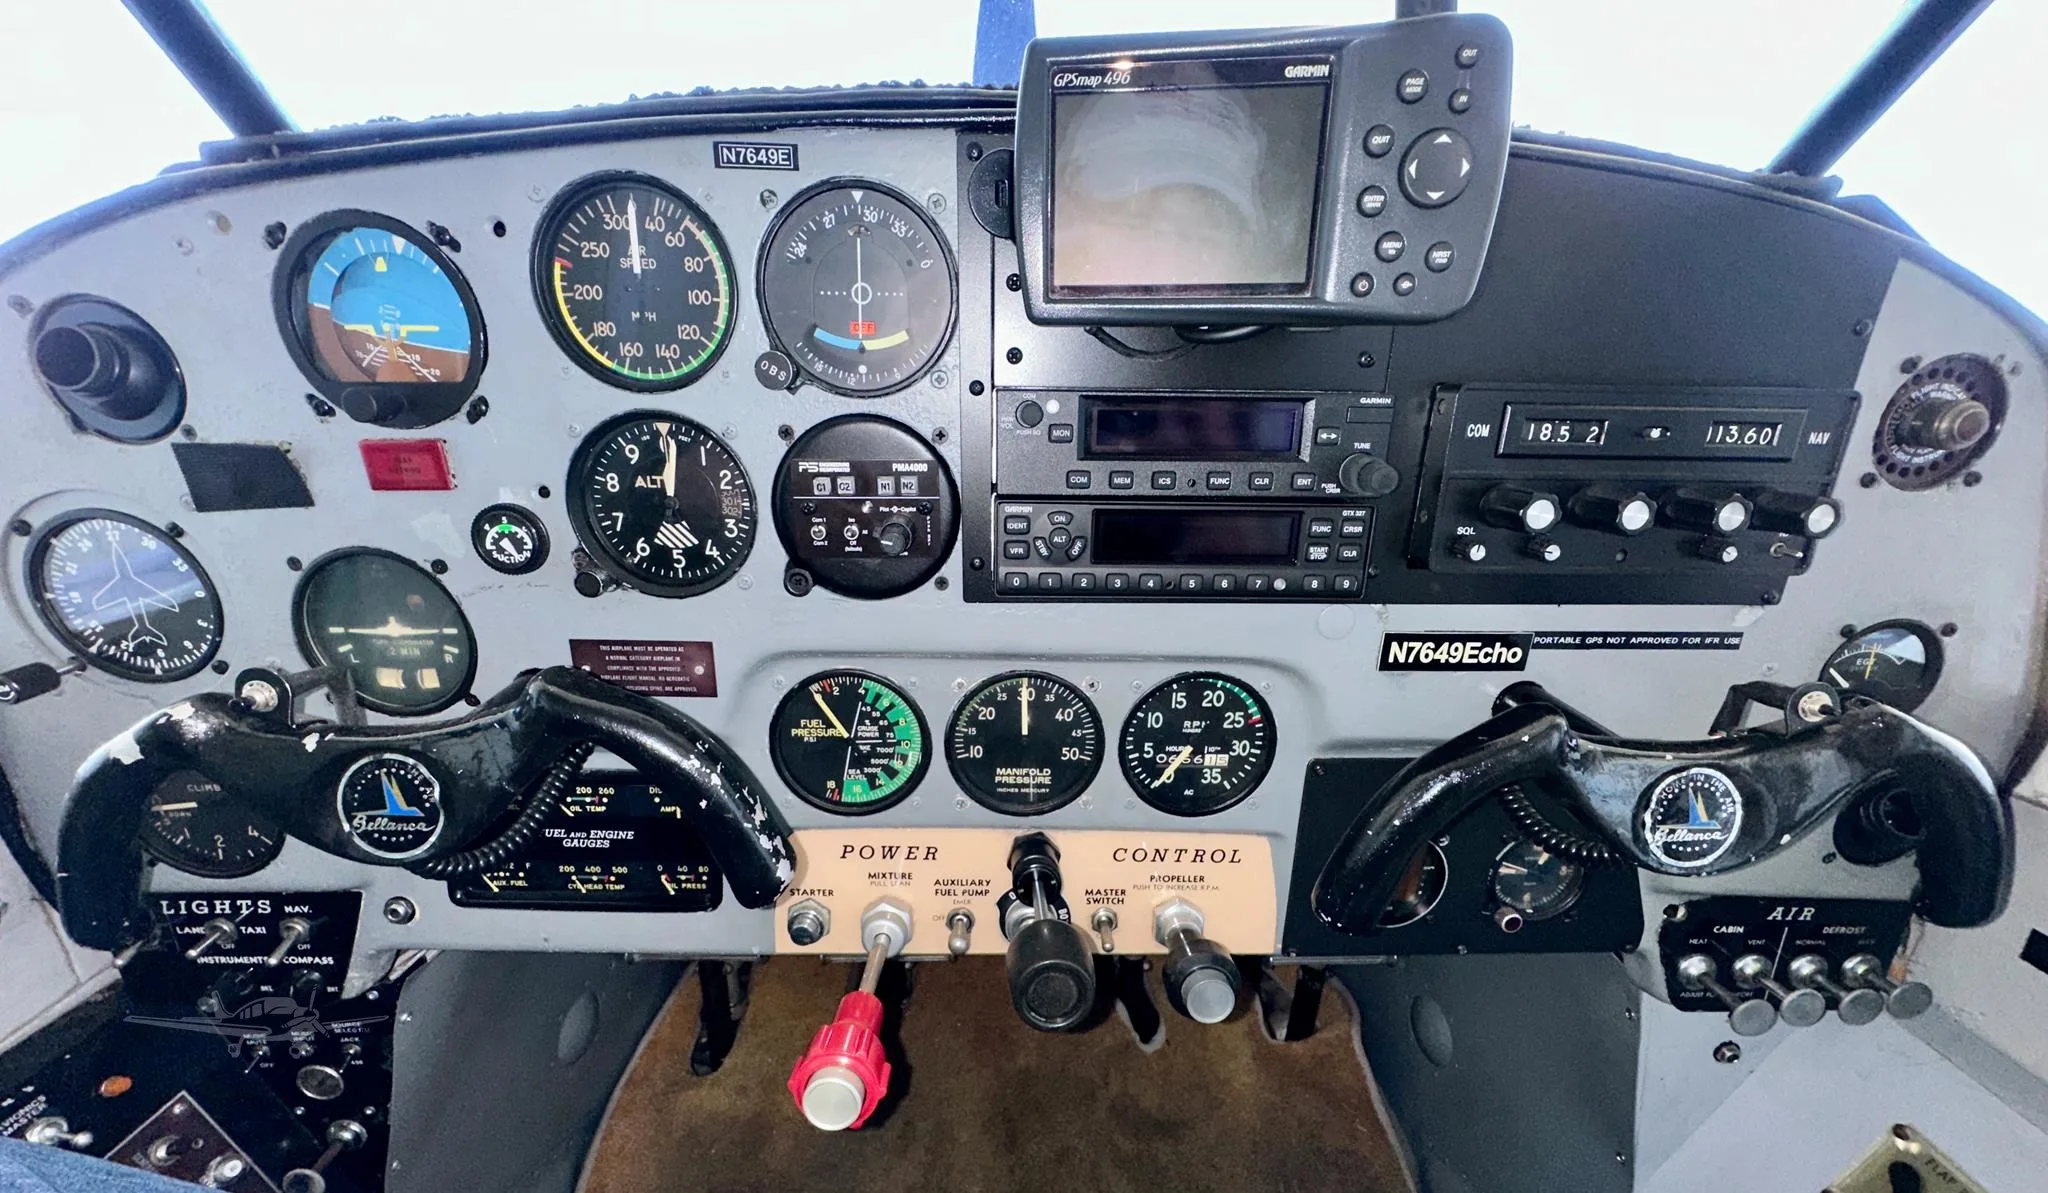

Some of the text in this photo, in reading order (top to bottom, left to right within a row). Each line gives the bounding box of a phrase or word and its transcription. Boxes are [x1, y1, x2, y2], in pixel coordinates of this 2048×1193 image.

[1462, 49, 1478, 57] OUT
[1284, 65, 1330, 78] GARMIN
[1053, 71, 1131, 88] GPSmap 496
[1405, 78, 1425, 86] PAGE
[1459, 95, 1468, 103] IN
[1371, 135, 1391, 144] QUIT
[722, 147, 790, 165] N7649E
[603, 214, 631, 231] 300
[822, 213, 836, 229] 27
[863, 211, 879, 223] 30
[644, 216, 665, 232] 40
[664, 232, 686, 248] 60
[1382, 241, 1402, 249] MENU
[580, 242, 610, 258] 250
[628, 246, 647, 256] AR
[620, 258, 657, 270] SPED
[684, 256, 704, 273] 80
[573, 284, 603, 300] 200
[687, 289, 712, 306] 100
[593, 321, 616, 337] 180
[677, 324, 700, 340] 120
[853, 323, 874, 333] OFF
[619, 342, 643, 357] 160
[655, 343, 680, 359] 140
[760, 360, 787, 381] OBS
[1052, 429, 1070, 437] MON
[1467, 424, 1490, 438] COM
[1808, 432, 1831, 445] NAV
[624, 443, 640, 465] 9
[700, 445, 706, 466] 1
[798, 462, 818, 473] PS
[892, 463, 928, 472] PMA4000
[605, 472, 620, 493] 8
[634, 475, 663, 488] ALT
[719, 470, 732, 490] 2
[839, 481, 851, 492] C2
[880, 481, 892, 492] N1
[902, 480, 914, 490] N2
[1158, 477, 1171, 485] ICS
[1209, 477, 1230, 485] FUNC
[816, 482, 827, 492] C1
[611, 512, 624, 532] 7
[724, 518, 738, 538] 3
[1312, 525, 1332, 533] FUNC
[1456, 526, 1476, 535] SQL
[1053, 535, 1067, 543] ALT
[636, 537, 650, 557] 6
[705, 539, 720, 558] 4
[1035, 539, 1049, 557] STBY
[1071, 541, 1083, 556] OFF
[492, 550, 531, 564] SUCTION
[672, 549, 687, 569] 5
[172, 557, 189, 573] 33
[1533, 636, 1741, 645] PORTABLE GPS NOT APPROVED FOR IFR USE
[389, 647, 421, 656] 2 MIN
[1388, 641, 1522, 664] N7649Echo
[350, 653, 360, 664] L
[444, 654, 454, 664] R
[997, 692, 1008, 701] 25
[1017, 688, 1036, 701] 30
[1044, 693, 1055, 702] 35
[1171, 692, 1187, 709] 15
[1201, 691, 1225, 707] 20
[978, 707, 996, 720] 20
[1055, 708, 1074, 722] 40
[1147, 711, 1163, 728] 10
[1222, 711, 1245, 729] 25
[800, 719, 826, 728] FUEL
[791, 728, 843, 737] PRESSURE
[968, 727, 977, 735] 15
[1071, 729, 1083, 737] 45
[969, 746, 984, 758] 10
[1061, 747, 1080, 761] 50
[1143, 742, 1154, 758] 5
[1229, 740, 1250, 757] 30
[996, 767, 1052, 776] MANIFOLD
[1200, 768, 1221, 784] 35
[995, 775, 1052, 784] PRESSURE
[186, 783, 222, 792] CLIMB
[576, 786, 593, 794] 200
[598, 787, 615, 795] 260
[1693, 774, 1705, 782] IN
[1710, 778, 1726, 793] THE
[1725, 797, 1735, 814] AIR
[352, 814, 436, 833] Bellanca
[247, 824, 259, 837] 4
[543, 829, 567, 838] UEL
[589, 830, 634, 839] ENGINE
[213, 834, 225, 847] 2
[563, 838, 610, 848] GAUGES
[1653, 828, 1729, 847] Bellanca
[840, 844, 939, 861] POWER
[1112, 848, 1242, 864] CONTROL
[612, 866, 628, 874] 500
[867, 872, 913, 880] MIXTURE
[933, 879, 991, 887] AUXILIARY
[1150, 875, 1205, 883] PROPELLER
[789, 888, 834, 897] STARTER
[935, 888, 991, 897] FUEL PUMP
[1084, 888, 1126, 897] MASTER
[1086, 896, 1125, 905] SWITCH
[160, 900, 272, 915] LIGHTS
[283, 905, 313, 913] NAV.
[1766, 906, 1816, 921] AIR
[239, 926, 267, 934] TAXI
[1713, 925, 1744, 934] CABIN
[1822, 926, 1867, 934] DEFROST
[283, 956, 334, 965] COMPASS
[2, 1102, 48, 1137] MASTER
